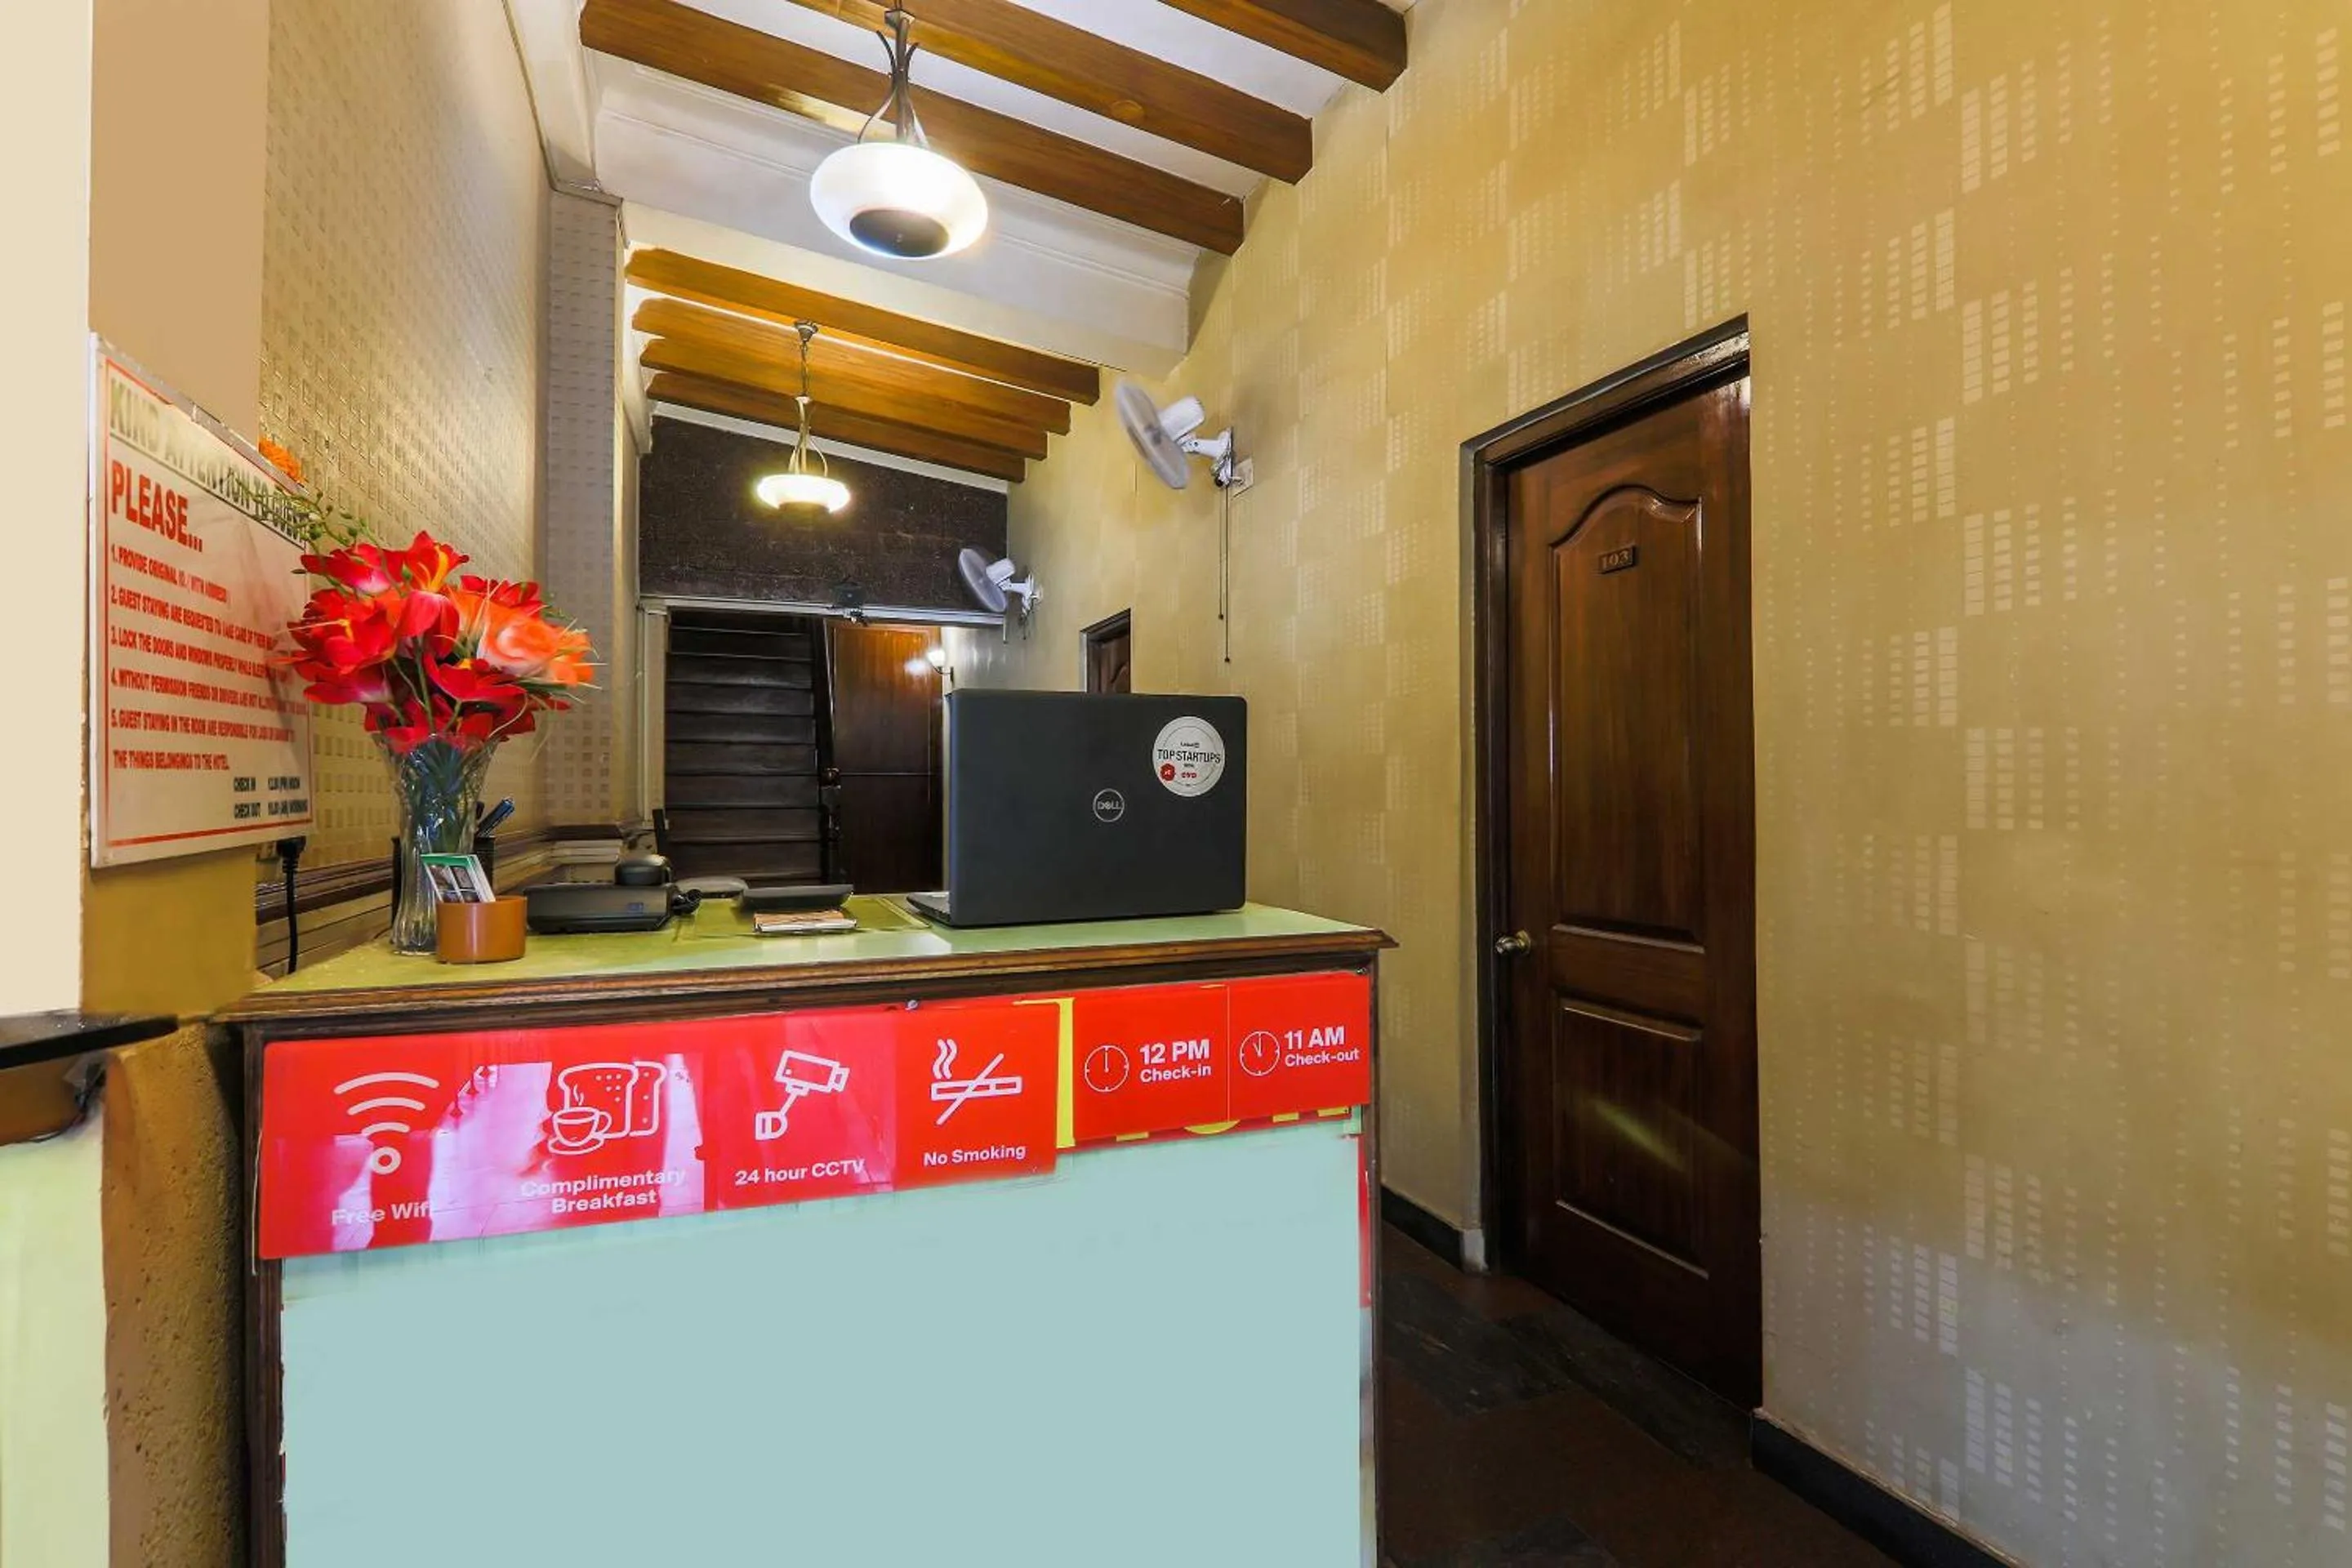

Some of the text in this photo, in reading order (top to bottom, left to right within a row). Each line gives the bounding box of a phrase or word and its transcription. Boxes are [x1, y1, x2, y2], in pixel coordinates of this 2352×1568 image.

[118, 586, 140, 609] GUEST
[142, 595, 169, 618] STAYING
[171, 604, 181, 622] ARE
[118, 627, 136, 648] LOCK
[139, 632, 150, 652] THE
[152, 636, 174, 657] DOORS
[175, 642, 186, 660] AND
[119, 668, 149, 689] WITHOUT
[119, 709, 140, 728] GUEST
[142, 712, 169, 730] STAYING
[171, 715, 177, 731] IN
[179, 716, 190, 732] THE
[113, 751, 127, 768] THE
[1157, 749, 1221, 764] TOP STARTUPS
[234, 777, 249, 791] CHECK
[234, 803, 249, 818] CHECK
[1097, 800, 1122, 810] DELL
[1284, 1026, 1345, 1050] 11 AM
[1139, 1039, 1210, 1065] 12 PM
[1285, 1049, 1360, 1067] Check-out
[1140, 1064, 1212, 1084] Check-in
[924, 1145, 1027, 1167] No Smoking
[520, 1169, 686, 1197] Complimentary
[735, 1159, 866, 1186] 24 hour CCTV
[551, 1189, 657, 1214] Breakfast
[332, 1209, 386, 1226] Free
